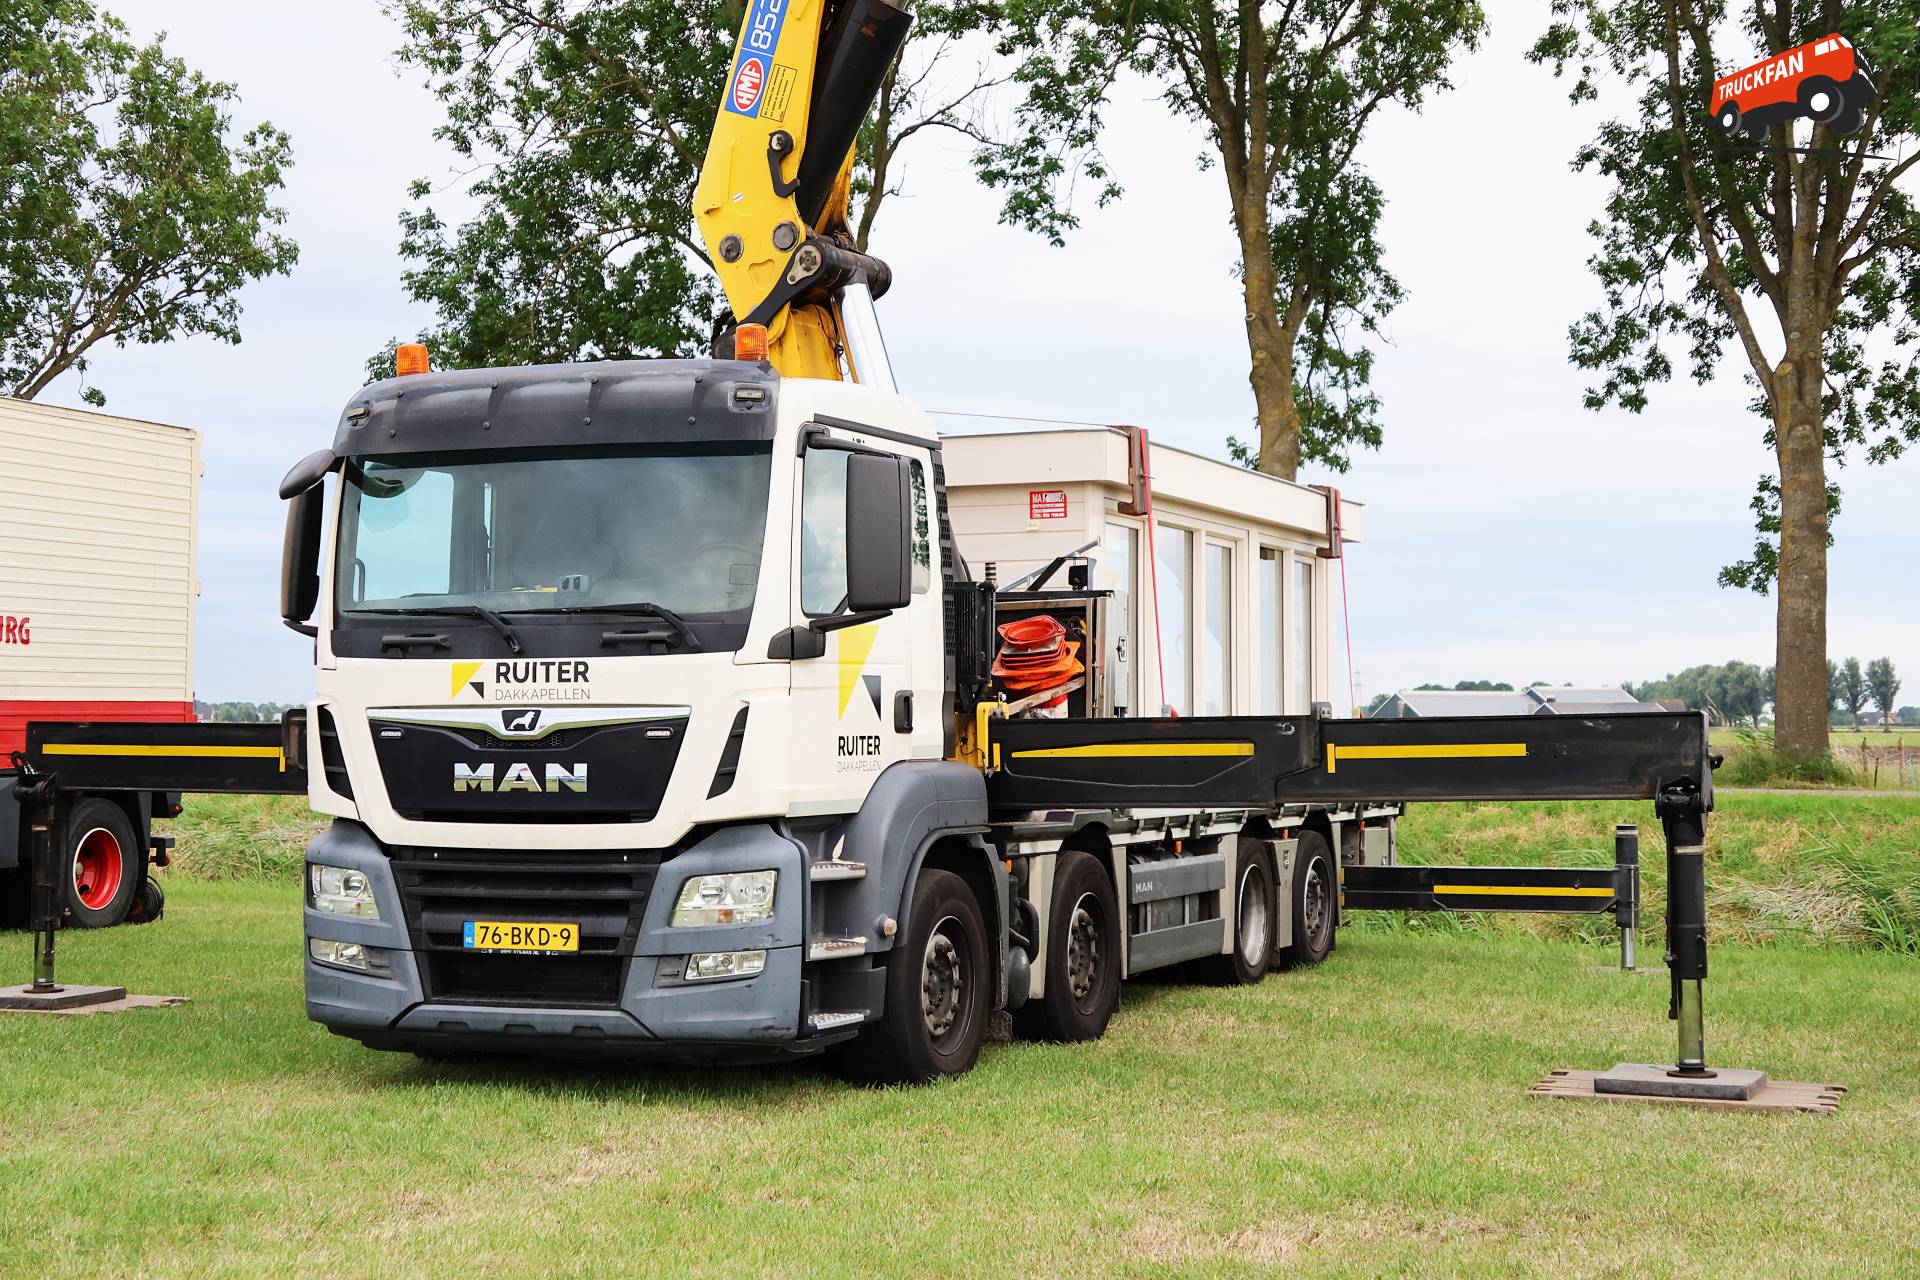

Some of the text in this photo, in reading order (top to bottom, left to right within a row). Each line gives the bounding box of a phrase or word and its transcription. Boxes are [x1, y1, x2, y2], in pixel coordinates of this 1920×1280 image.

[736, 65, 760, 105] HMF
[495, 661, 590, 684] RUITER
[495, 688, 591, 701] DAKKAPELLEN
[838, 735, 880, 756] RUITER
[453, 762, 588, 793] MAN
[1135, 880, 1153, 894] MAN
[480, 926, 571, 947] 76-BKD-9
